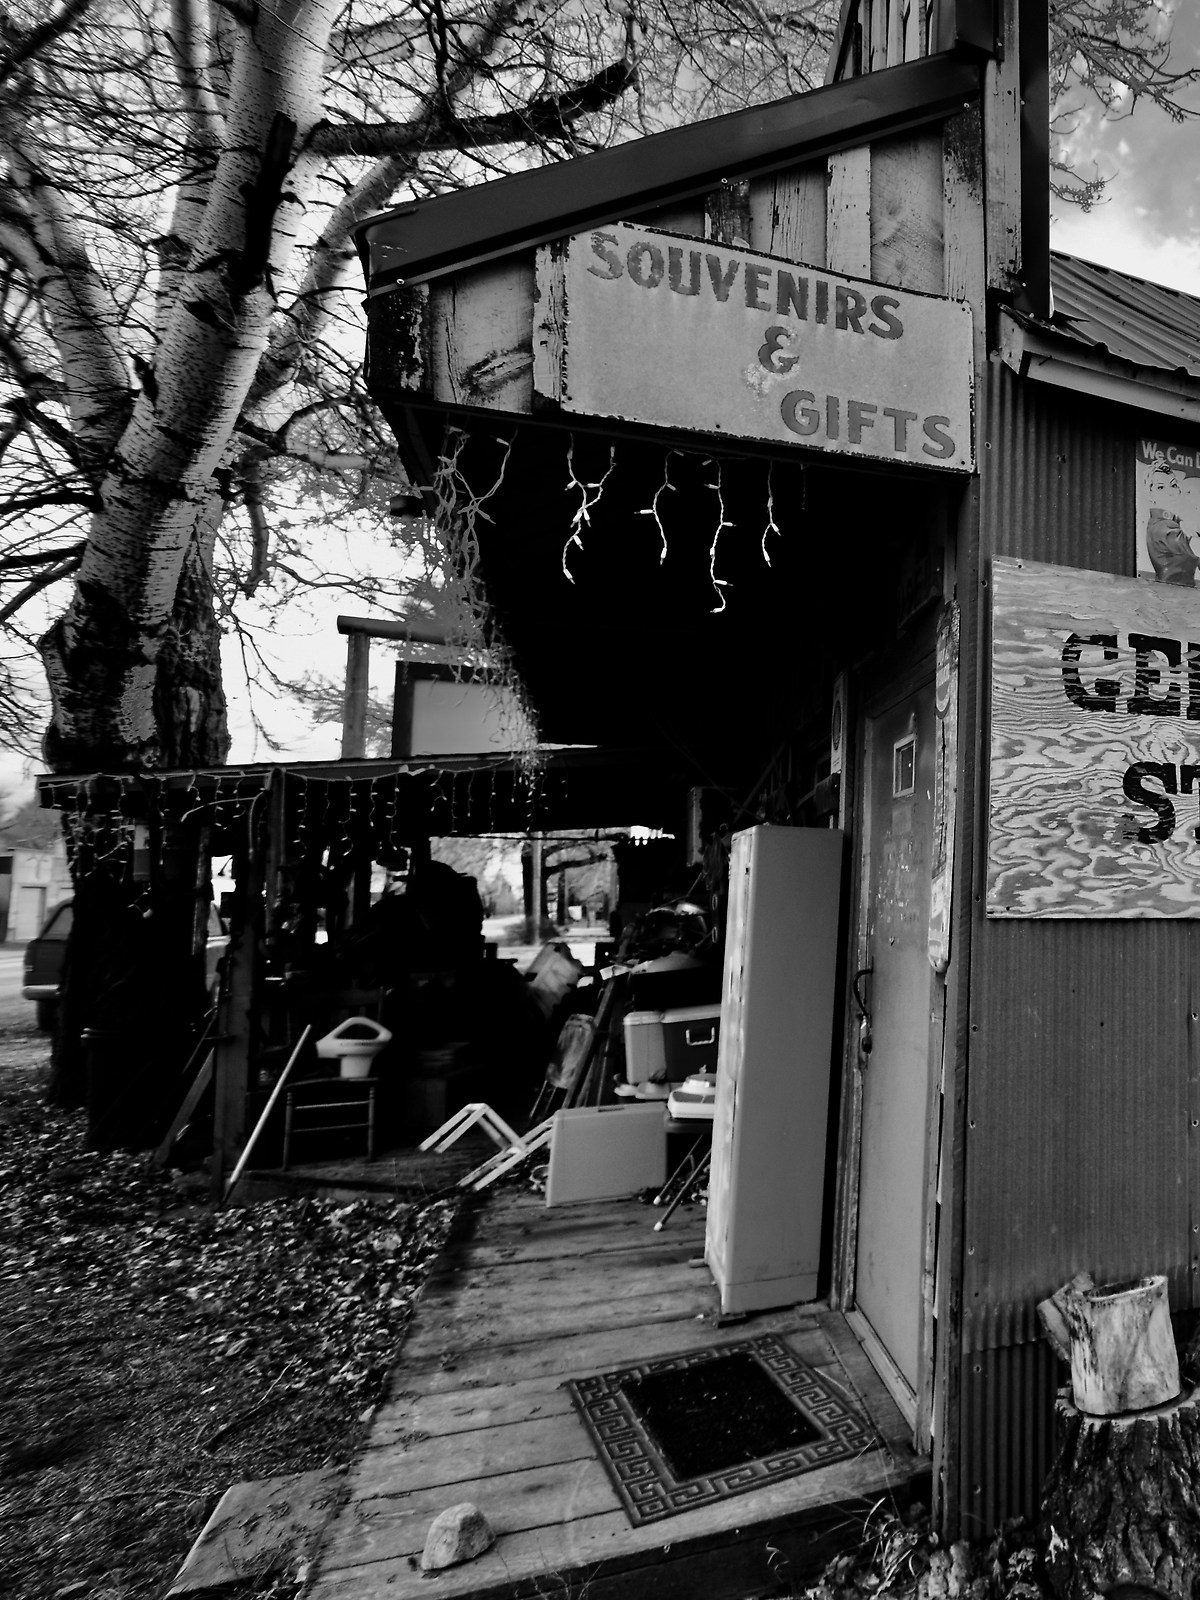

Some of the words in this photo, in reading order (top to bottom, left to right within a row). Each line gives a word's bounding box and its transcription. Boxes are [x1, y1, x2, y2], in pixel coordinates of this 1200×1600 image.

[587, 231, 904, 340] SOUVENIRS
[757, 325, 800, 374] &
[780, 390, 956, 459] GIFTS
[1141, 439, 1165, 460] We
[1166, 446, 1193, 467] Can
